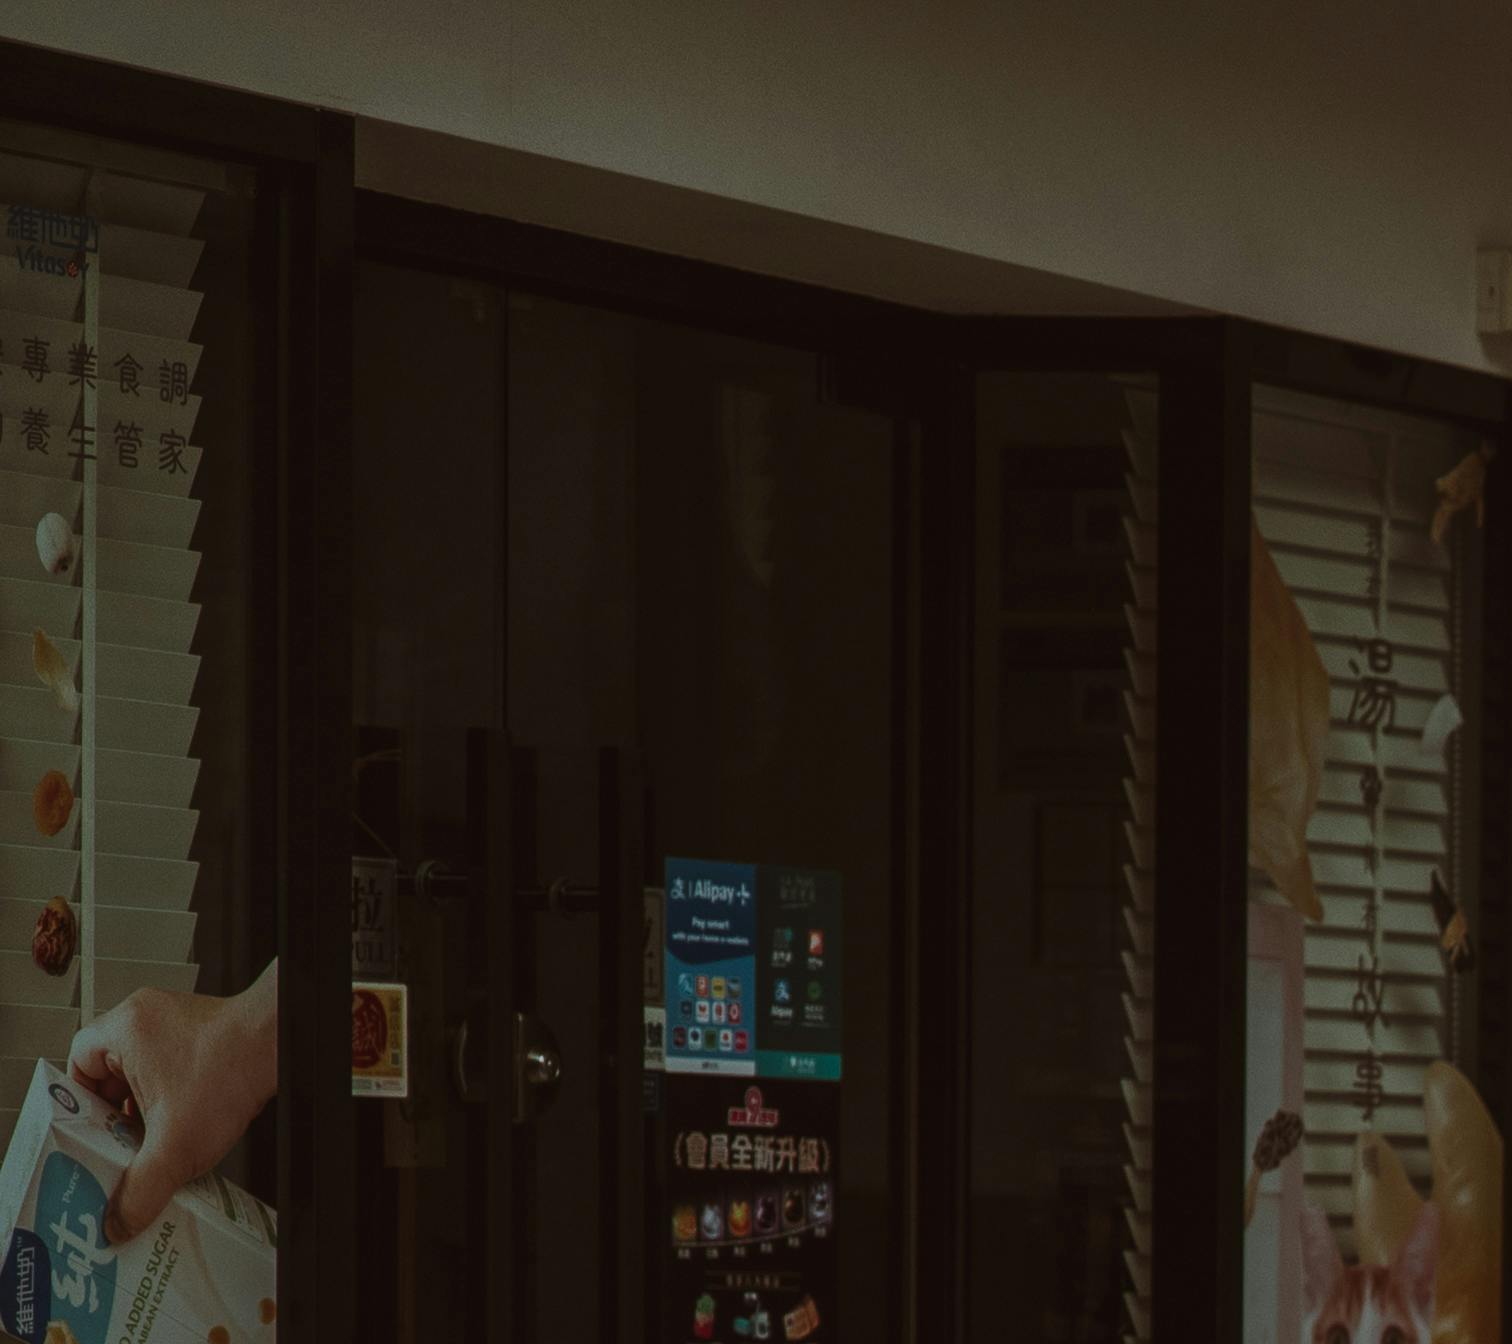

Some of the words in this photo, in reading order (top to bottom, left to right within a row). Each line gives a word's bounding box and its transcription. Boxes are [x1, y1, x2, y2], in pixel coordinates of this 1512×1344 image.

[8, 204, 98, 253] 維他奶
[0, 336, 189, 406] 專業食調
[0, 407, 189, 475] 養生管家
[352, 942, 383, 961] ULL
[126, 1275, 153, 1337] ADDED
[149, 1219, 177, 1277] SUGAR
[155, 1249, 181, 1306] EXTRACT
